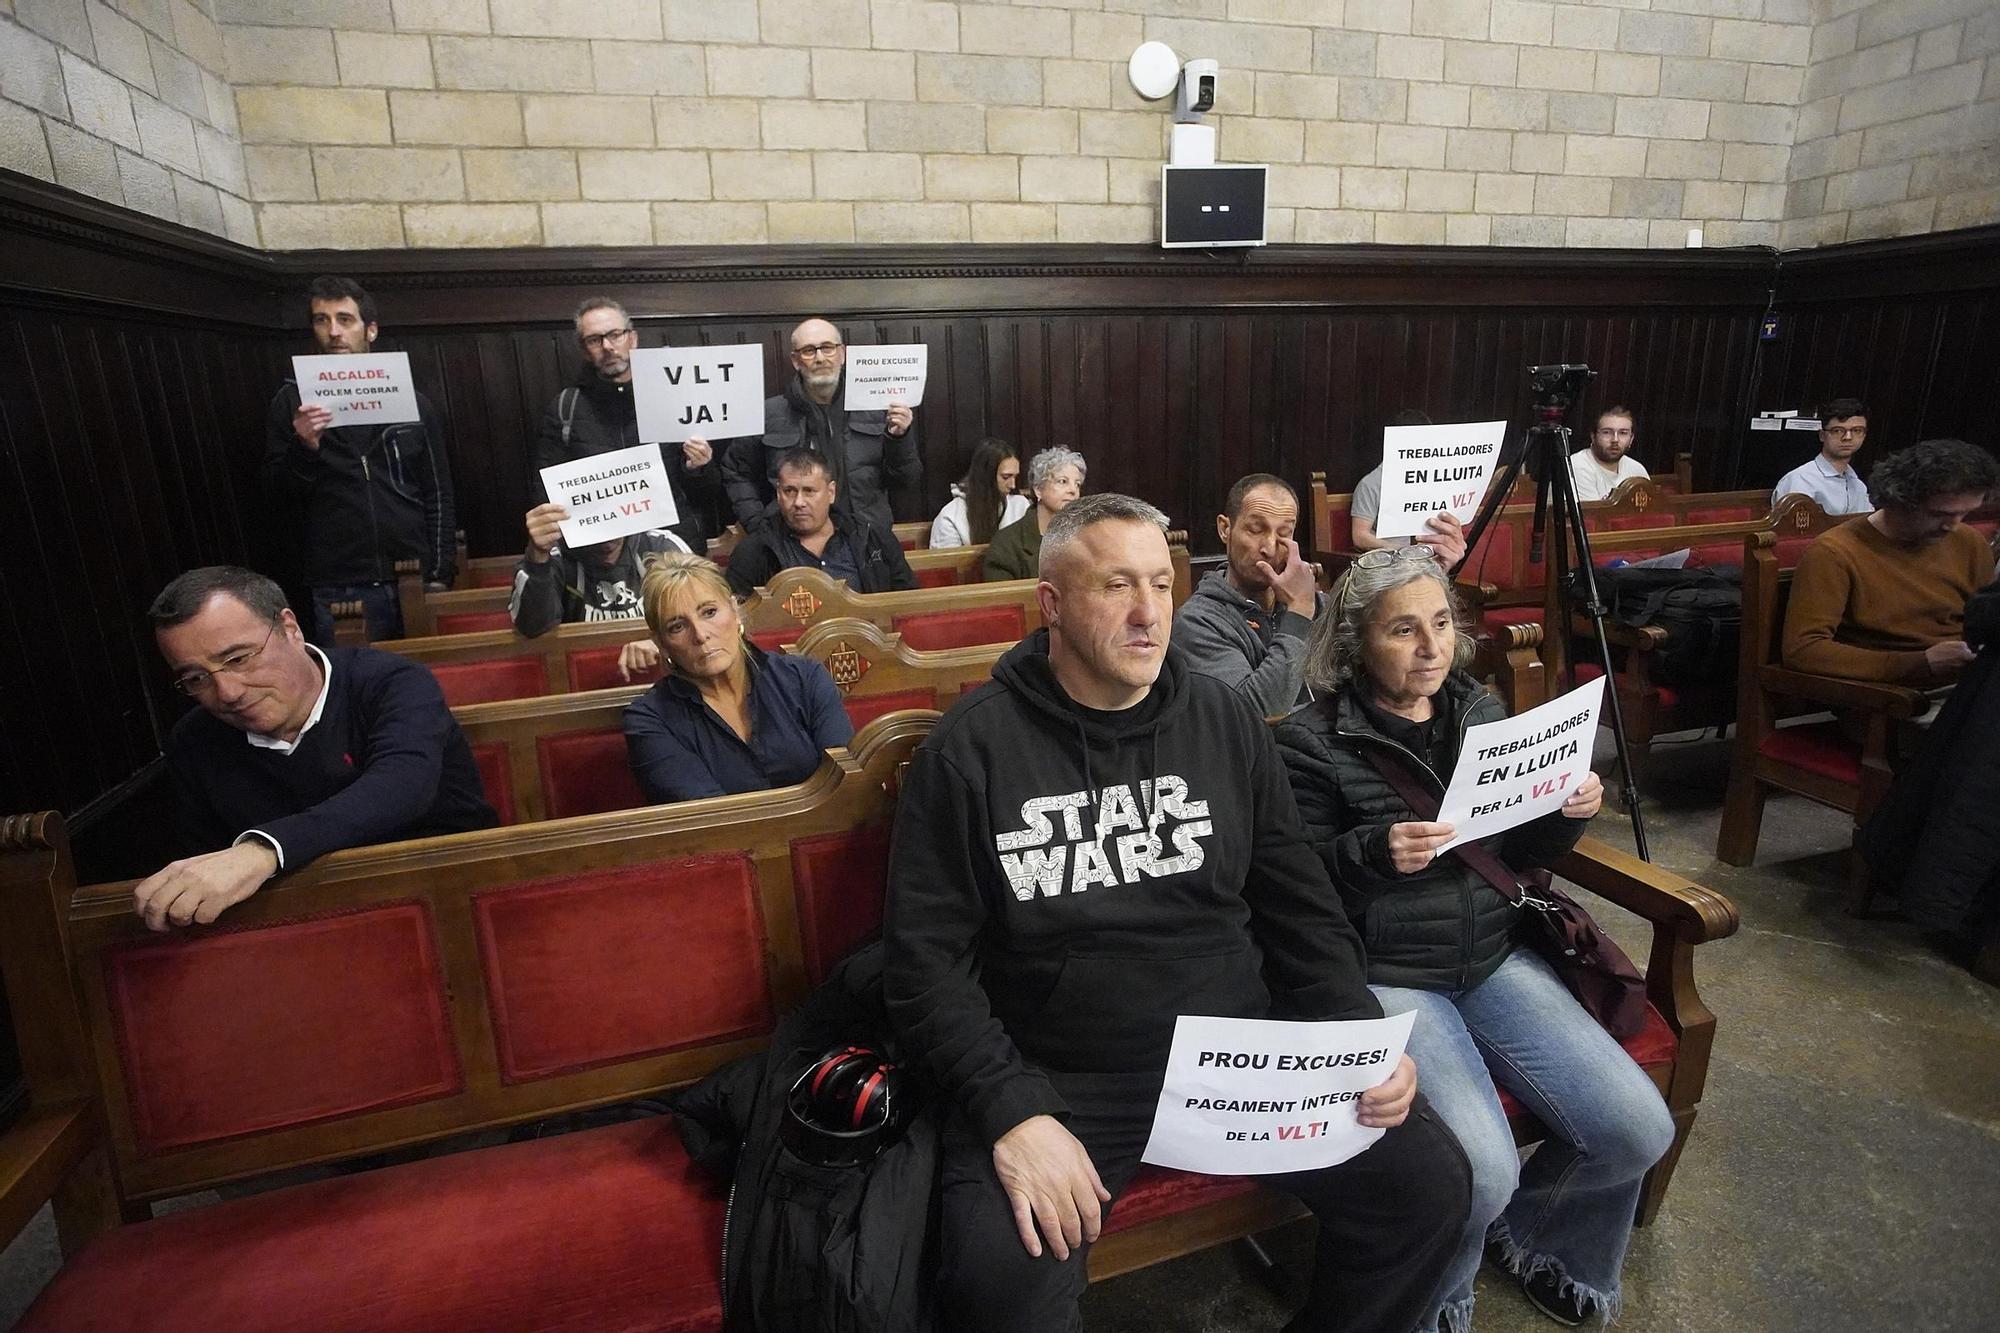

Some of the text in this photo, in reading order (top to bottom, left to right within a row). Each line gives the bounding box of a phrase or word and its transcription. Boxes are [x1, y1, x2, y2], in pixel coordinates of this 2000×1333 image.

[856, 358, 879, 366] PROU
[319, 369, 390, 381] ALCALDE,
[315, 386, 399, 397] VOLEM COBRAR
[350, 401, 383, 411] VLT!
[1398, 444, 1493, 459] TREBALLADORES
[558, 461, 652, 490] TREBALLADORES
[1405, 465, 1483, 484] EN LLUITA
[571, 479, 649, 506] EN LLUITA
[1404, 492, 1475, 512] PER LA VLT
[579, 499, 651, 527] PER LA VLT
[1477, 709, 1590, 761] TREBALLADORES
[1476, 739, 1578, 786] EN LLUITA
[1470, 772, 1572, 818] PER LA VLT
[996, 774, 1211, 851] STAR
[999, 819, 1213, 901] WARS
[1198, 1048, 1388, 1071] PROU EXCUSES!
[1185, 1090, 1364, 1113] PAGAMENT ÍNTEGR
[1226, 1121, 1329, 1141] DE LA VLT!
